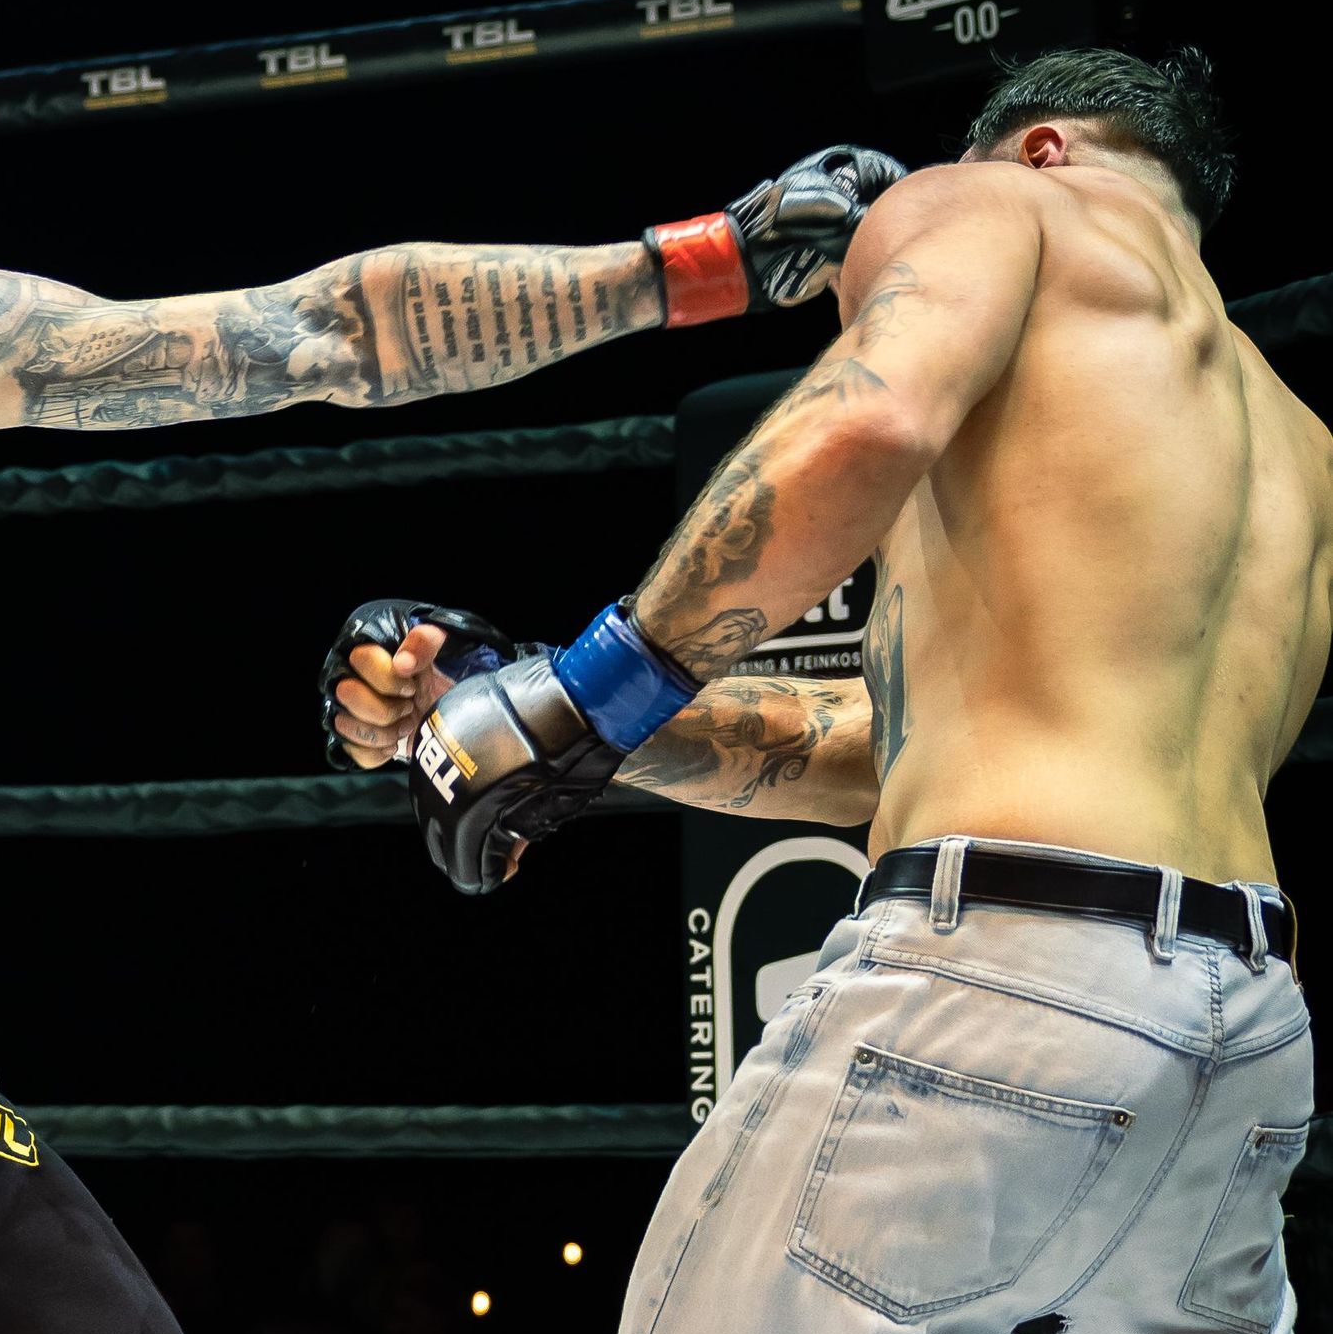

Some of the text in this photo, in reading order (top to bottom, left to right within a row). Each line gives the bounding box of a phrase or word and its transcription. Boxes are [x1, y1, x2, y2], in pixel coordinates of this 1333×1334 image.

[442, 19, 535, 52] TBL
[258, 44, 347, 76] TBL
[80, 65, 167, 97] TBL
[794, 651, 862, 671] FEINKOS
[687, 906, 715, 1124] CATERING
